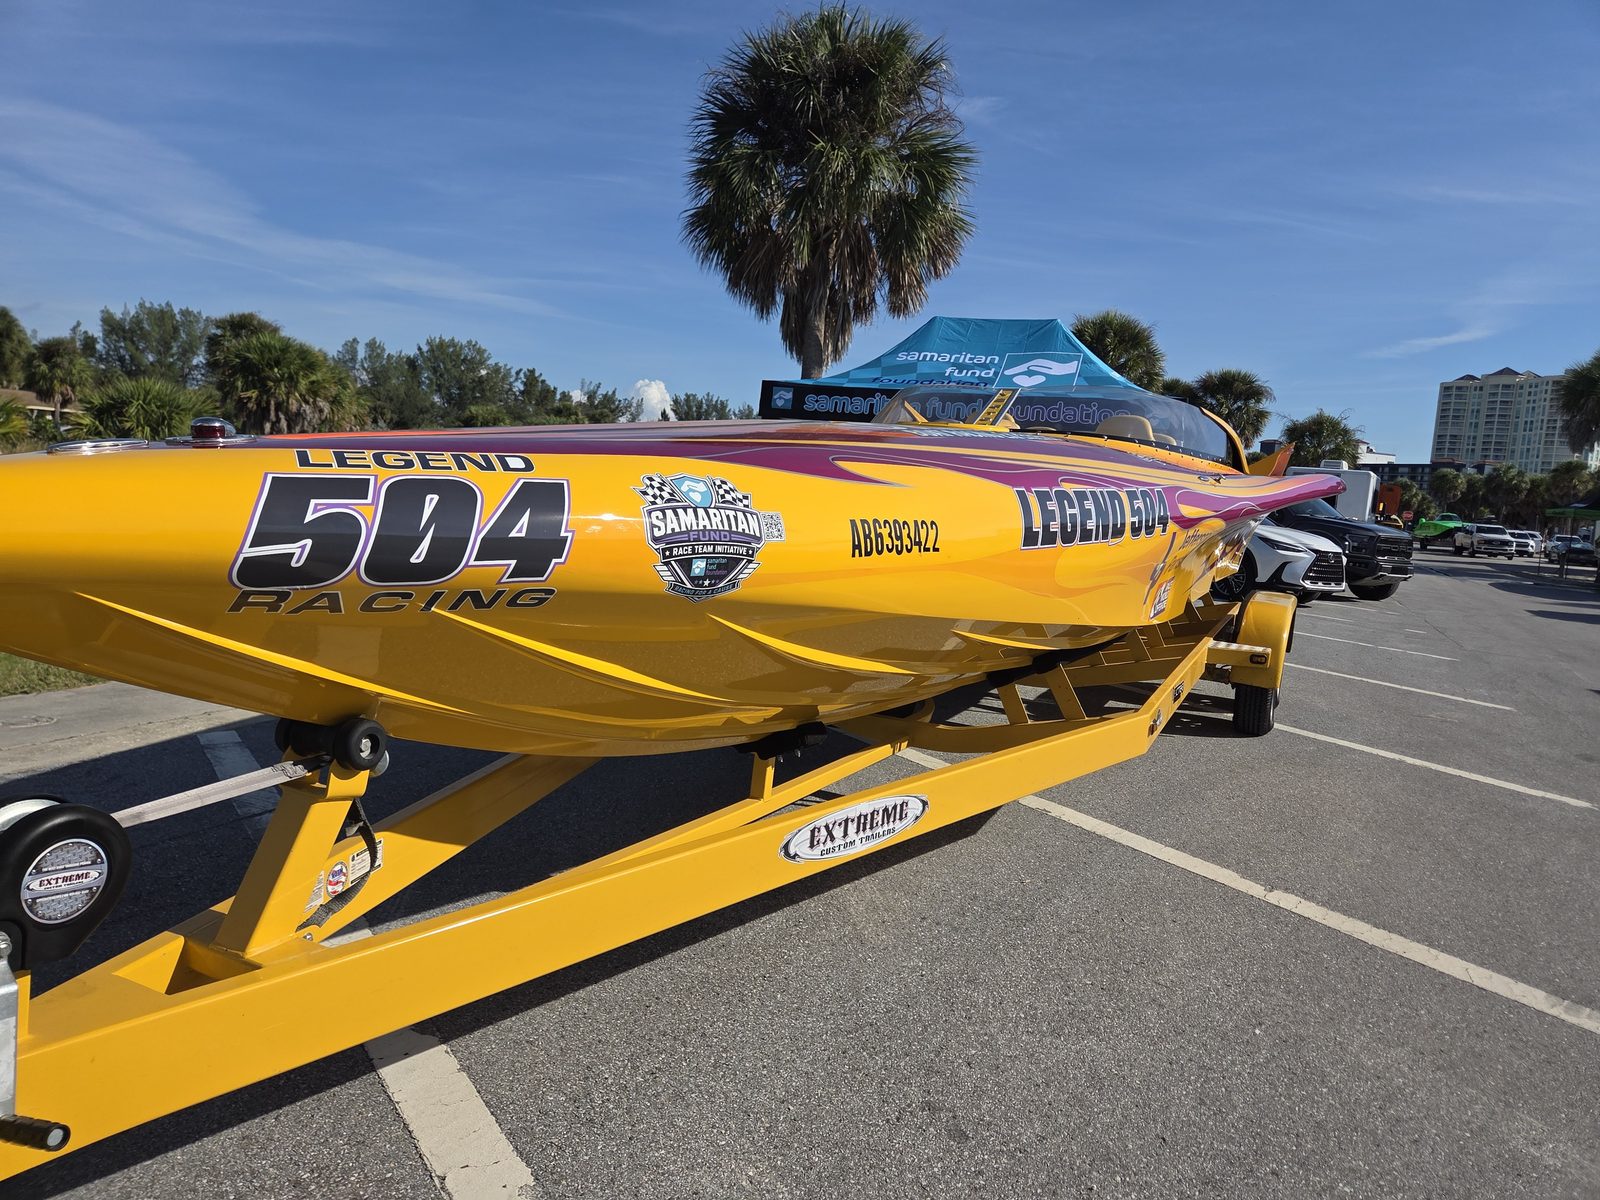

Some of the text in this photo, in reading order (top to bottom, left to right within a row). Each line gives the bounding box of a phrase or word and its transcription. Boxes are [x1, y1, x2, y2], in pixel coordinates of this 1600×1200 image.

[896, 351, 999, 364] samaritan
[871, 376, 989, 387] foundation
[944, 366, 995, 377] fund
[803, 392, 922, 416] samaritn
[925, 397, 983, 420] fund
[294, 449, 535, 473] LEGEND
[228, 472, 576, 590] 504
[651, 509, 760, 537] SAMARITAN
[1013, 487, 1125, 550] LEGEND
[1123, 487, 1170, 540] 504
[689, 530, 731, 542] FUND
[848, 518, 940, 558] AB6393422
[672, 545, 747, 556] RACE TEAM INITIATIVE
[225, 587, 557, 615] RACING
[674, 585, 694, 595] RACING
[808, 800, 909, 850] EXTREME
[820, 826, 896, 857] CUSTOM TRAILERS
[38, 871, 91, 888] EXTREME
